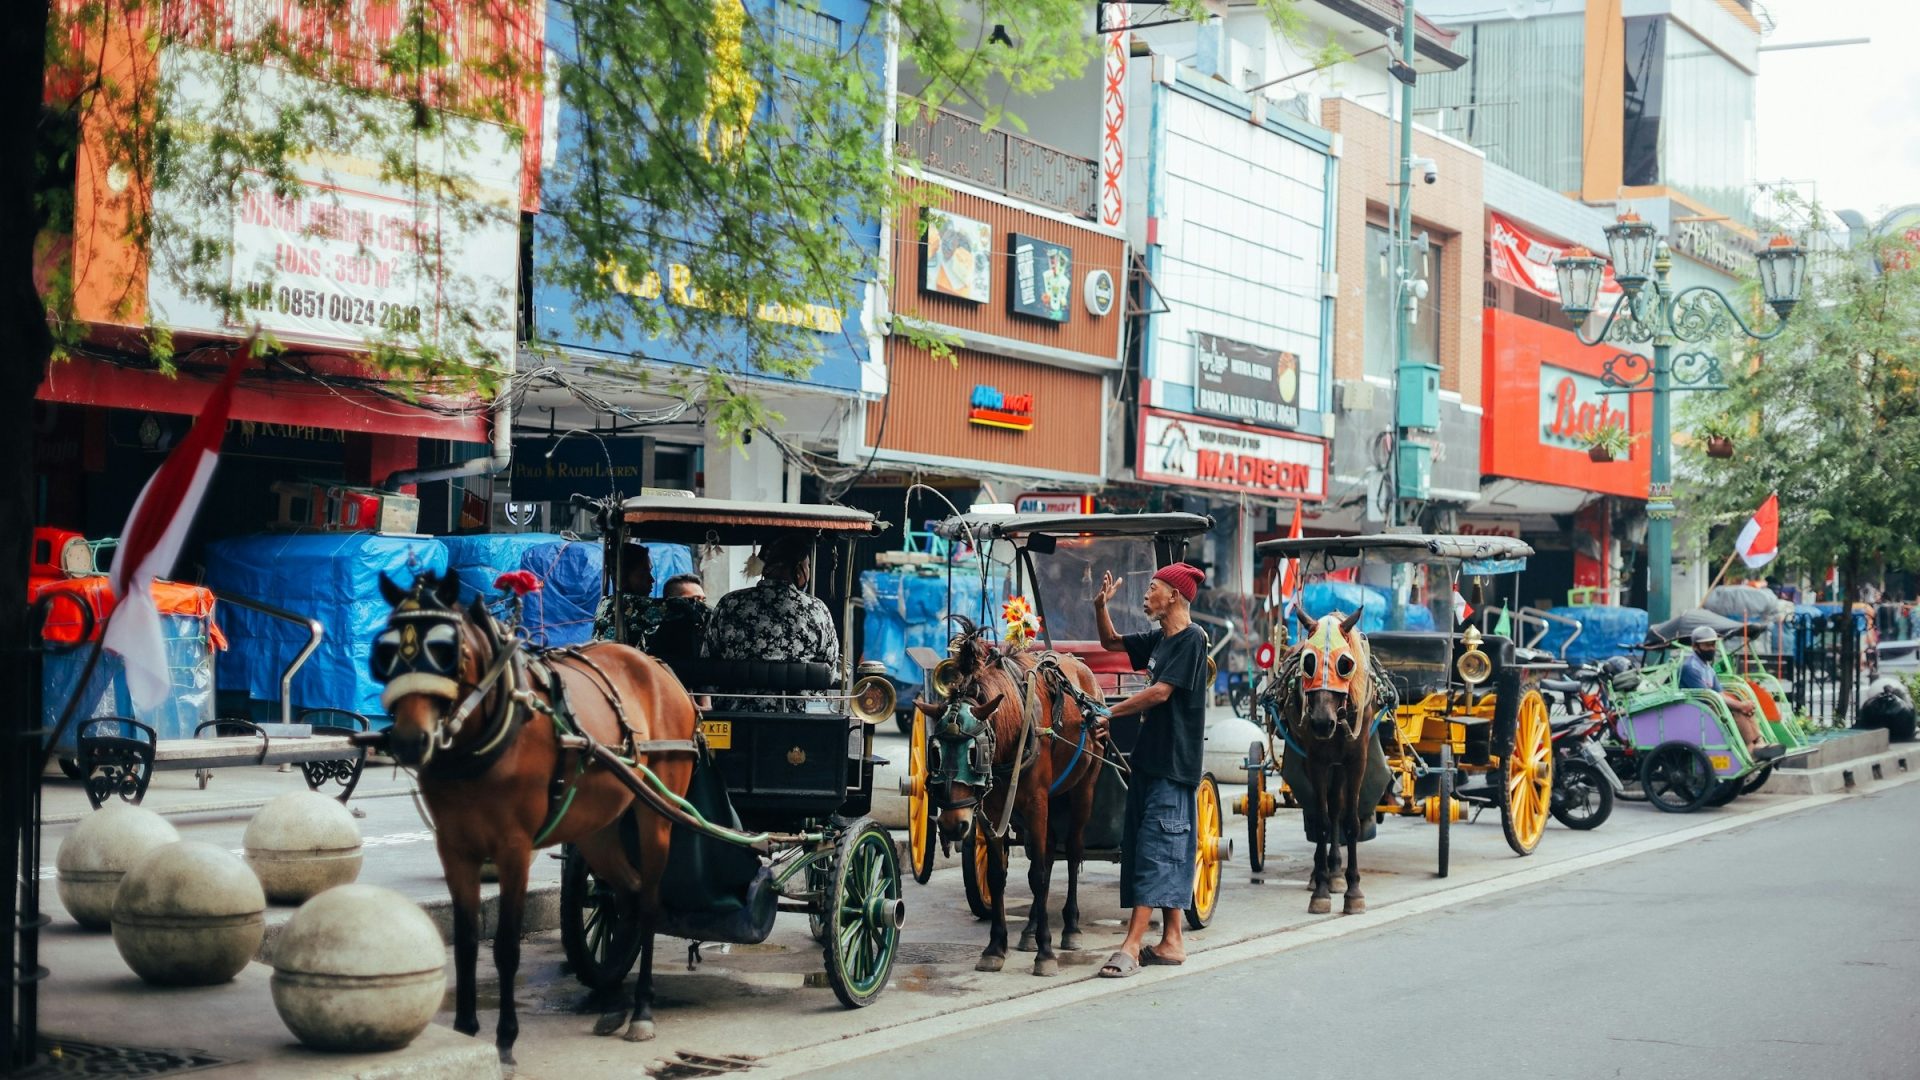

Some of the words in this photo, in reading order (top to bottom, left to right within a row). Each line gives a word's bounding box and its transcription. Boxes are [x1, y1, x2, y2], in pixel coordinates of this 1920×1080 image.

[242, 186, 303, 233] DIJUAL
[309, 202, 374, 246] MURAH
[276, 243, 321, 277] LUAS
[334, 254, 370, 285] 350
[278, 286, 325, 319] 0851
[329, 293, 375, 327] 0024
[1551, 376, 1625, 437] Bata
[516, 463, 542, 477] POLO
[558, 461, 593, 477] RALPH
[596, 461, 638, 477] LAUREN
[1197, 449, 1309, 489] MADISON
